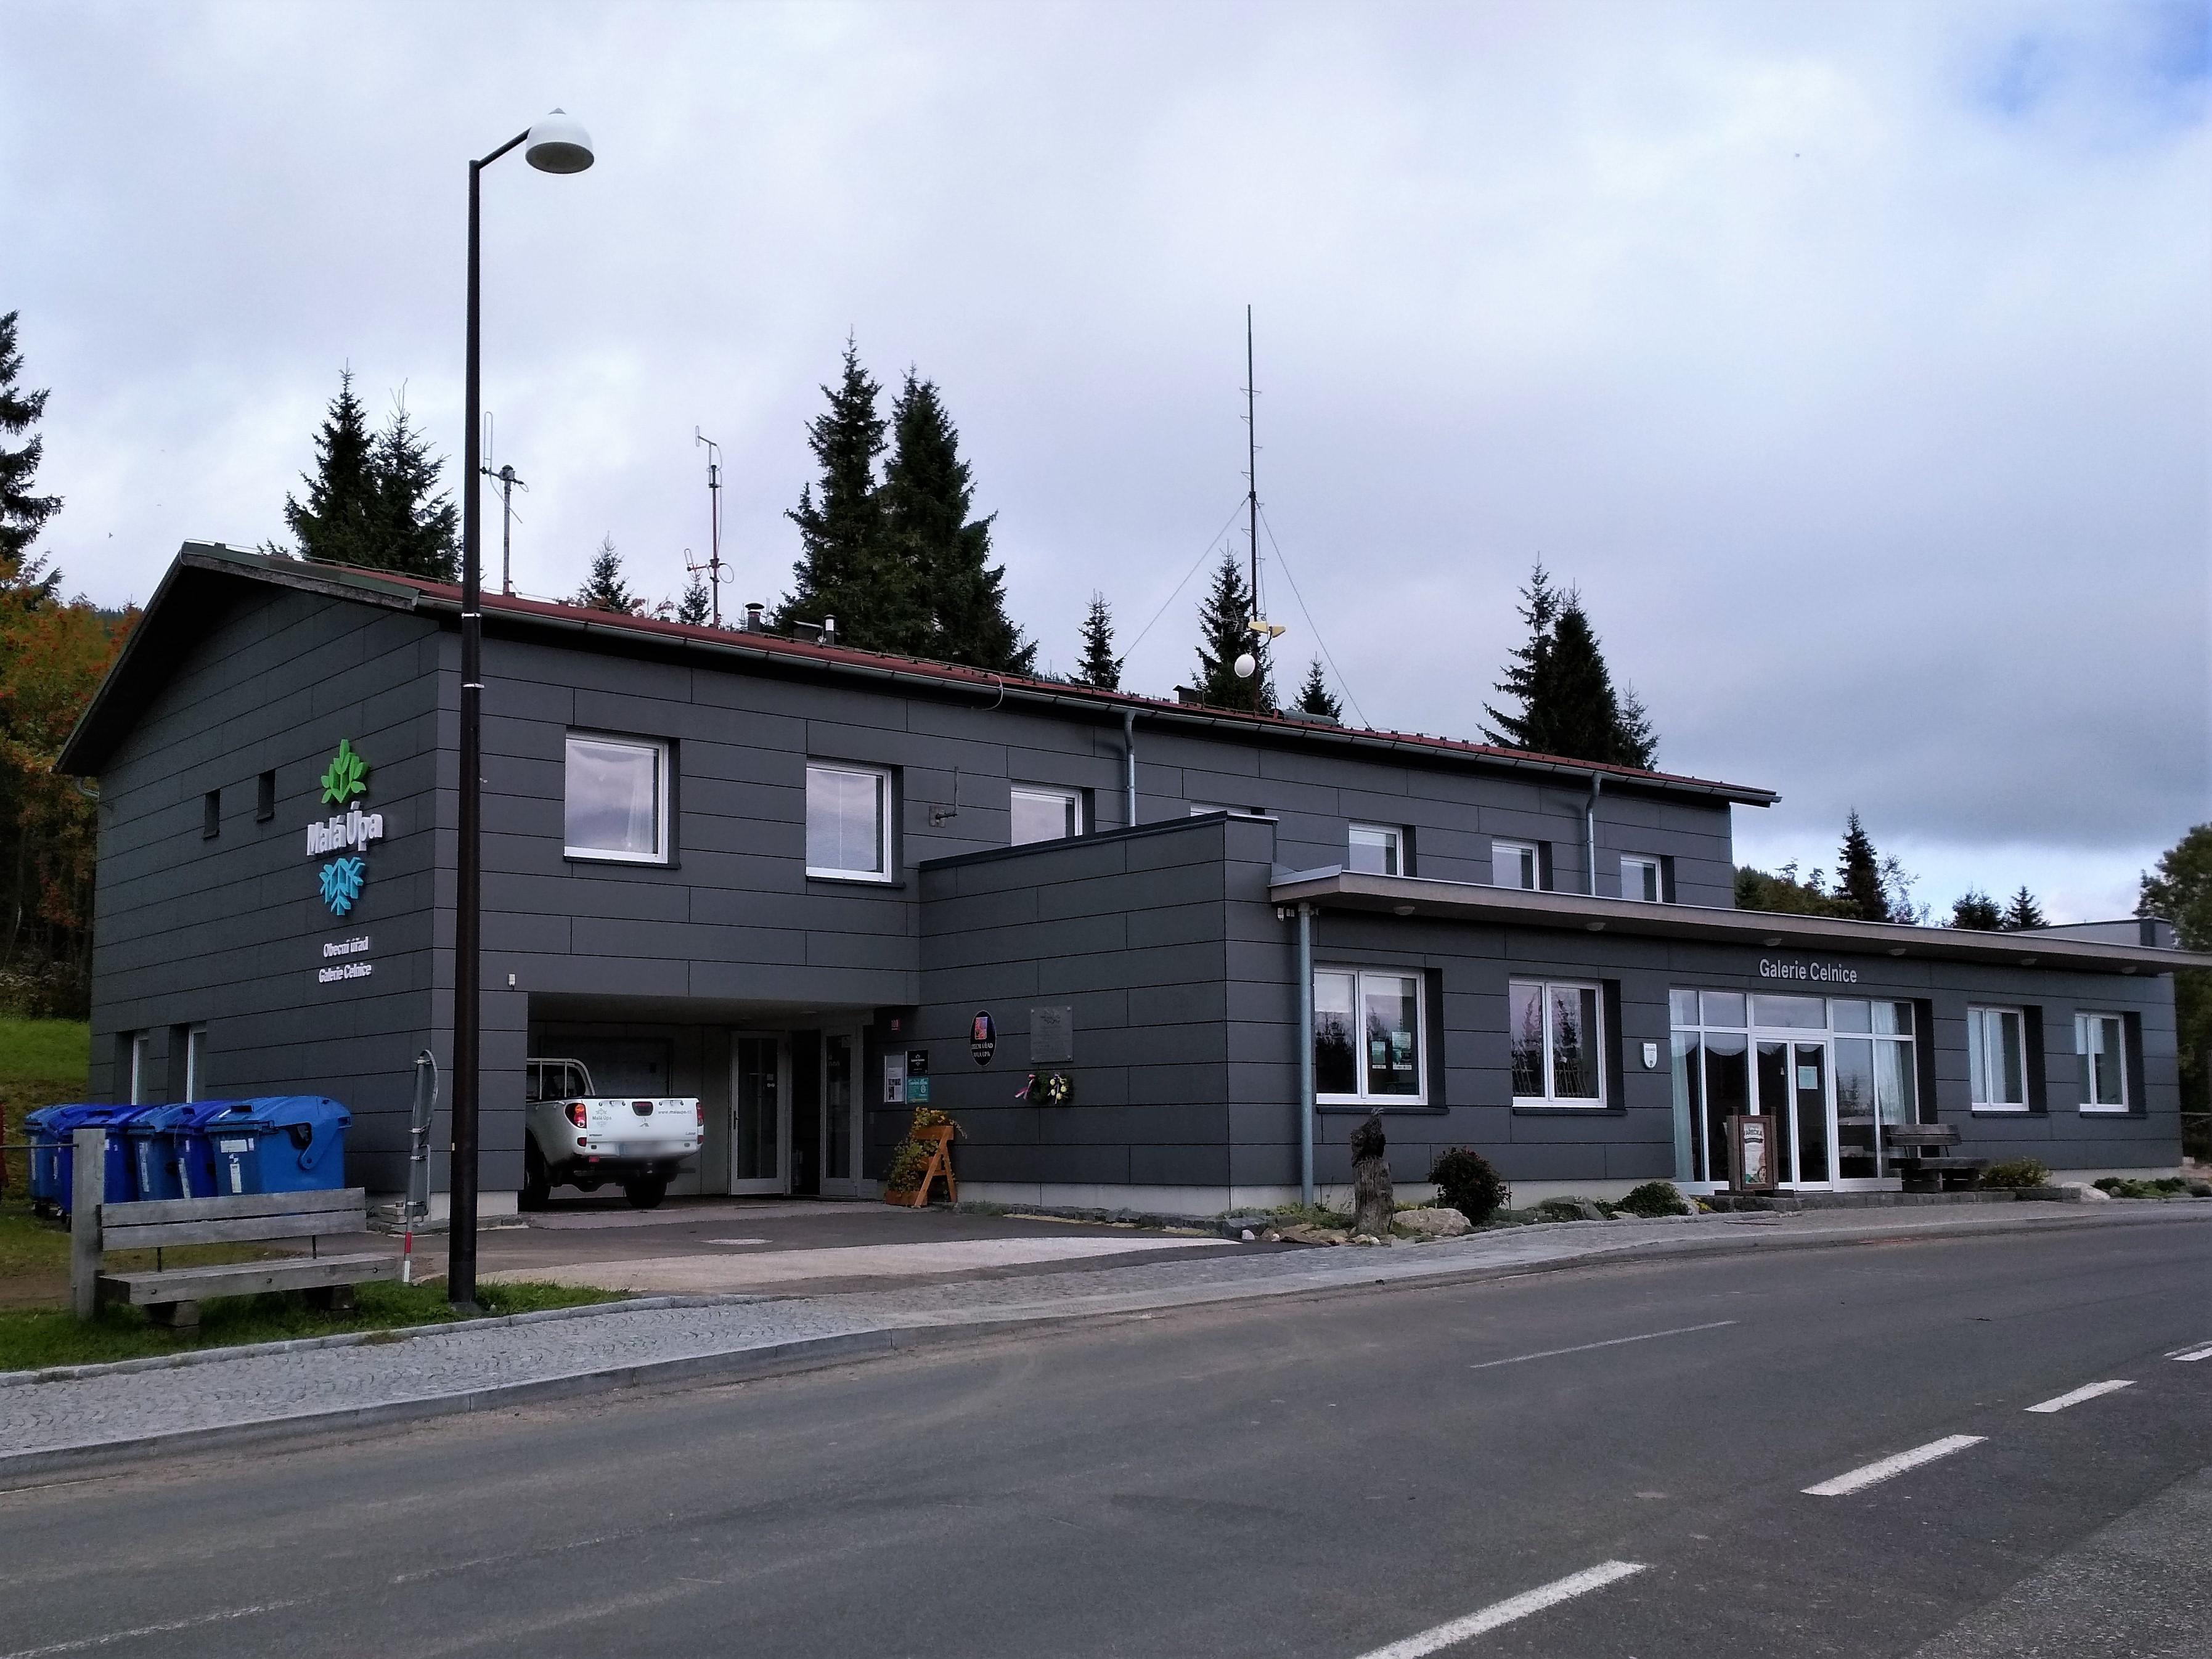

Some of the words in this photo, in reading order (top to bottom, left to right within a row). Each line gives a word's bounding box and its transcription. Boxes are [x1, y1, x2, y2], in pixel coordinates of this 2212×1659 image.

[307, 814, 346, 856] Malá
[346, 801, 383, 852] Úpa
[319, 966, 343, 983] Galerie
[344, 963, 372, 979] Celnice
[1759, 958, 1806, 980] Galerie
[1810, 962, 1858, 984] Celnice
